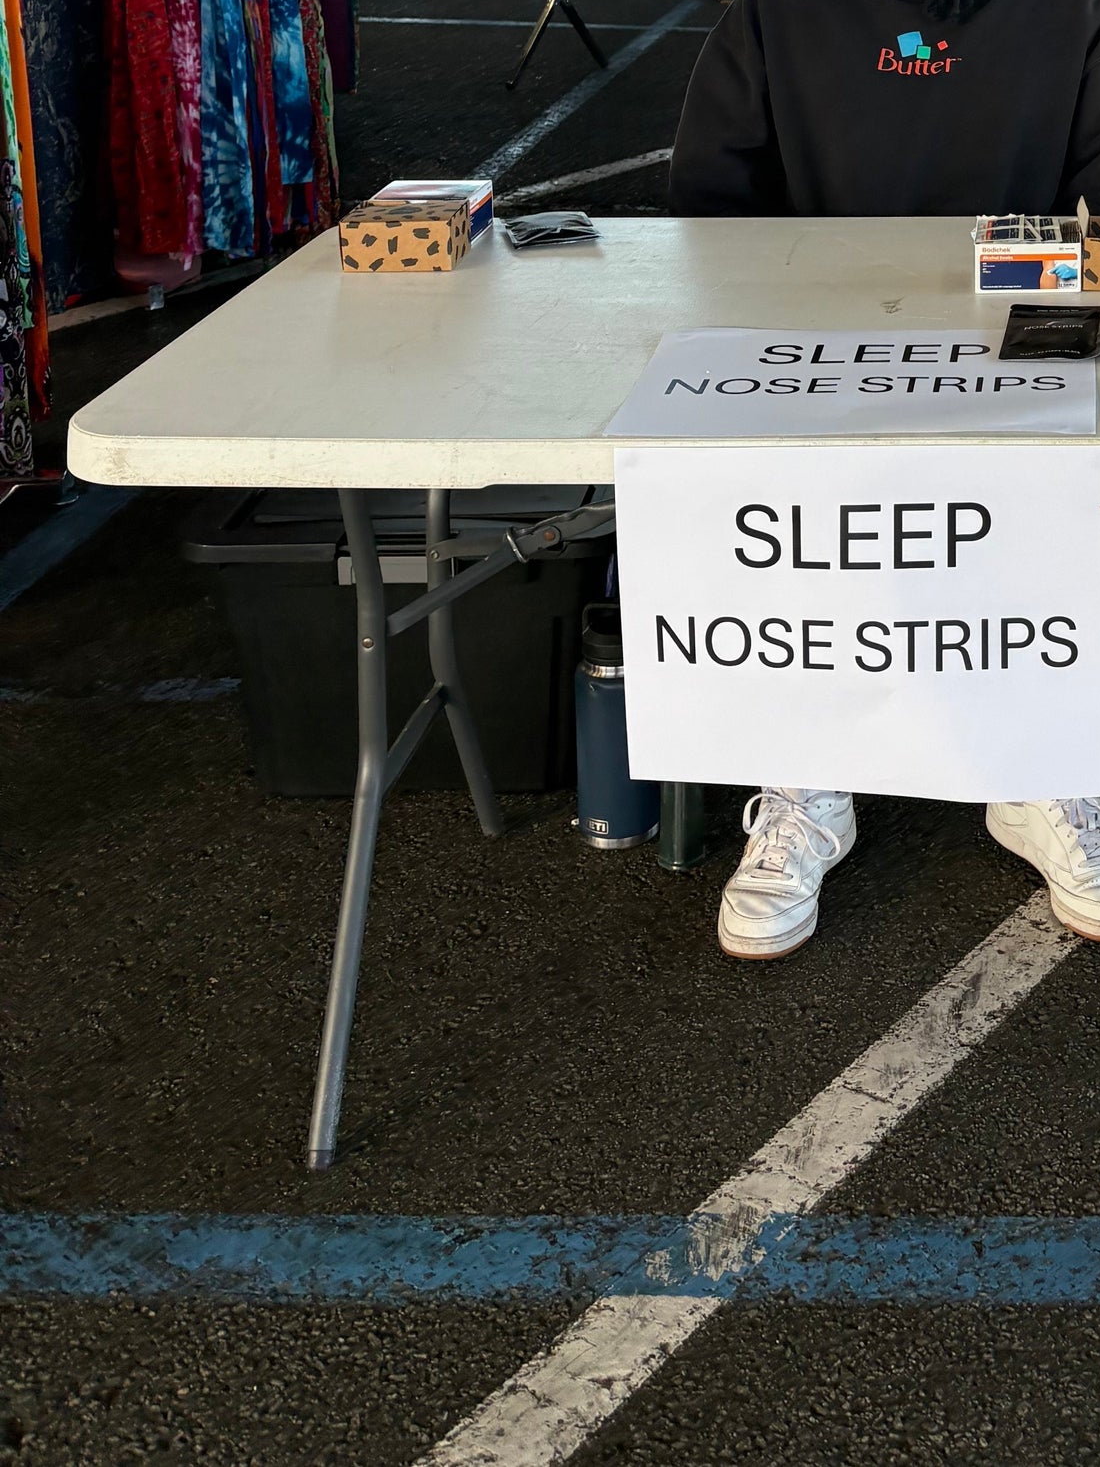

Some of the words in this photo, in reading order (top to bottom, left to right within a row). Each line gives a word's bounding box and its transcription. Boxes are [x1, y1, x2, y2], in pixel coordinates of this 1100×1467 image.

[877, 47, 957, 75] Butter
[758, 344, 991, 365] SLEEP
[664, 377, 842, 395] NOSE
[857, 375, 1067, 395] STRIPS
[734, 502, 992, 570] SLEEP
[655, 615, 835, 671] NOSE
[854, 616, 1079, 673] STRIPS
